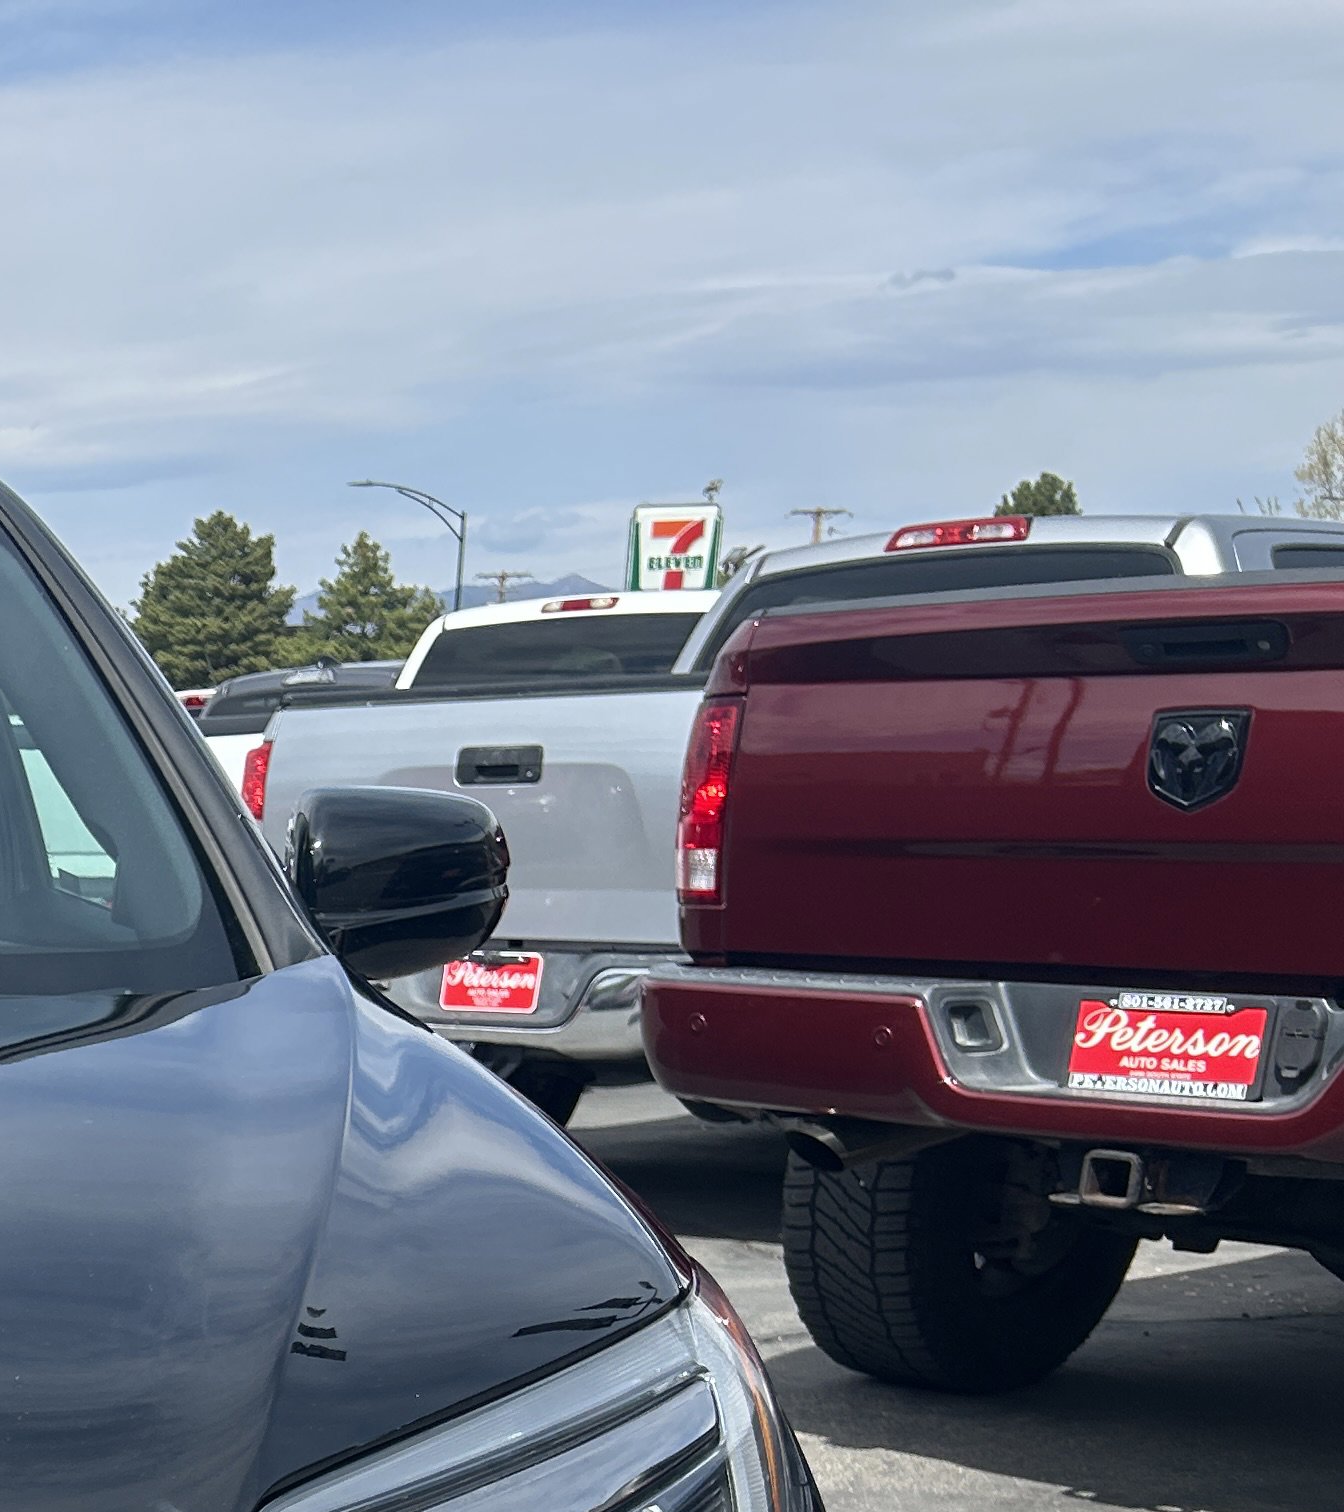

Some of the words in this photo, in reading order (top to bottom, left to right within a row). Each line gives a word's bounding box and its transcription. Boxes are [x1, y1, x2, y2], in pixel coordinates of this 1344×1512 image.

[653, 519, 704, 590] 7
[446, 960, 535, 990] Peterson
[1075, 1006, 1261, 1059] Peterson
[1119, 1055, 1157, 1070] AUTO
[1160, 1057, 1207, 1073] SALES
